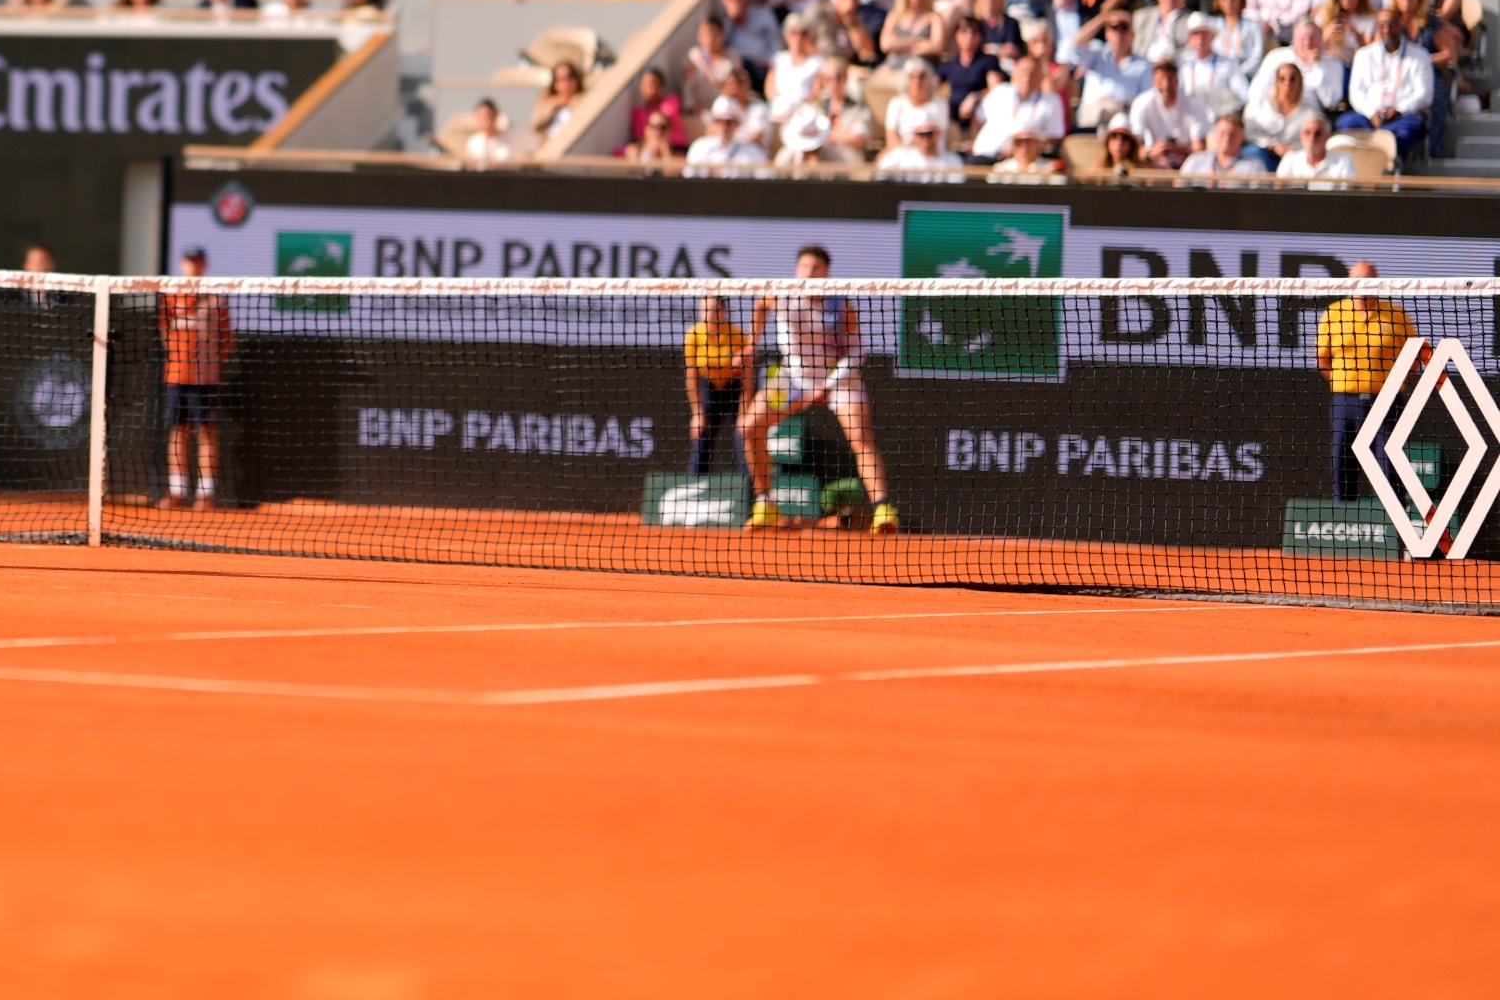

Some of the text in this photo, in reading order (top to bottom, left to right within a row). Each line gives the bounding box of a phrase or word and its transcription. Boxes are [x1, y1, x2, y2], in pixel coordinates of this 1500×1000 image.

[374, 238, 733, 278] BNP PARIBAS
[1101, 246, 1350, 348] BNP
[357, 407, 655, 458] BNP PARIBAS
[946, 429, 1264, 482] BNP PARIBAS
[1294, 522, 1388, 543] LACOSTE
